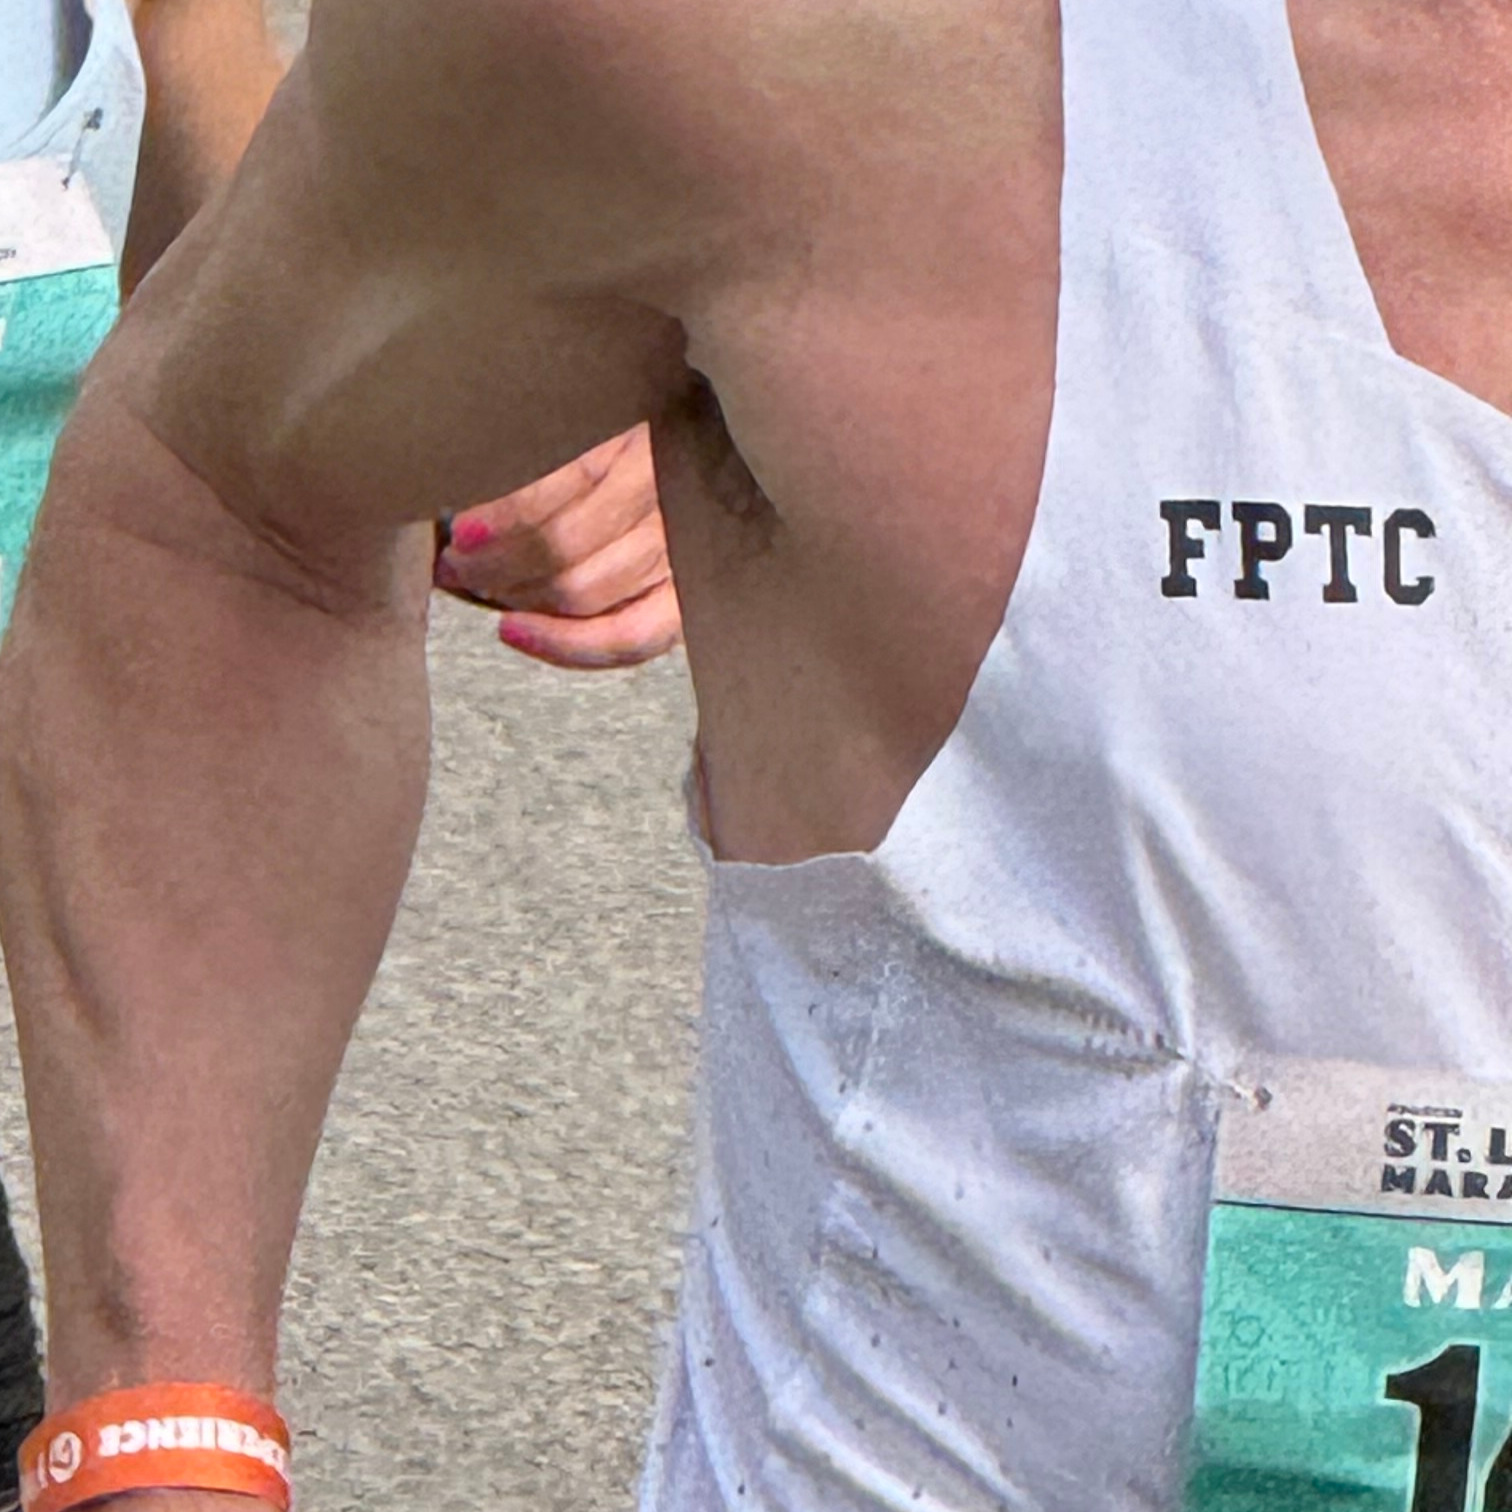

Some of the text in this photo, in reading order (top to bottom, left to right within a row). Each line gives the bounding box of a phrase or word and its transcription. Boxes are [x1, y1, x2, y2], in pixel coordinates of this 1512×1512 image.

[1159, 499, 1437, 606] FPTC
[1383, 1118, 1472, 1164] ST.
[1384, 1344, 1512, 1512] 1
